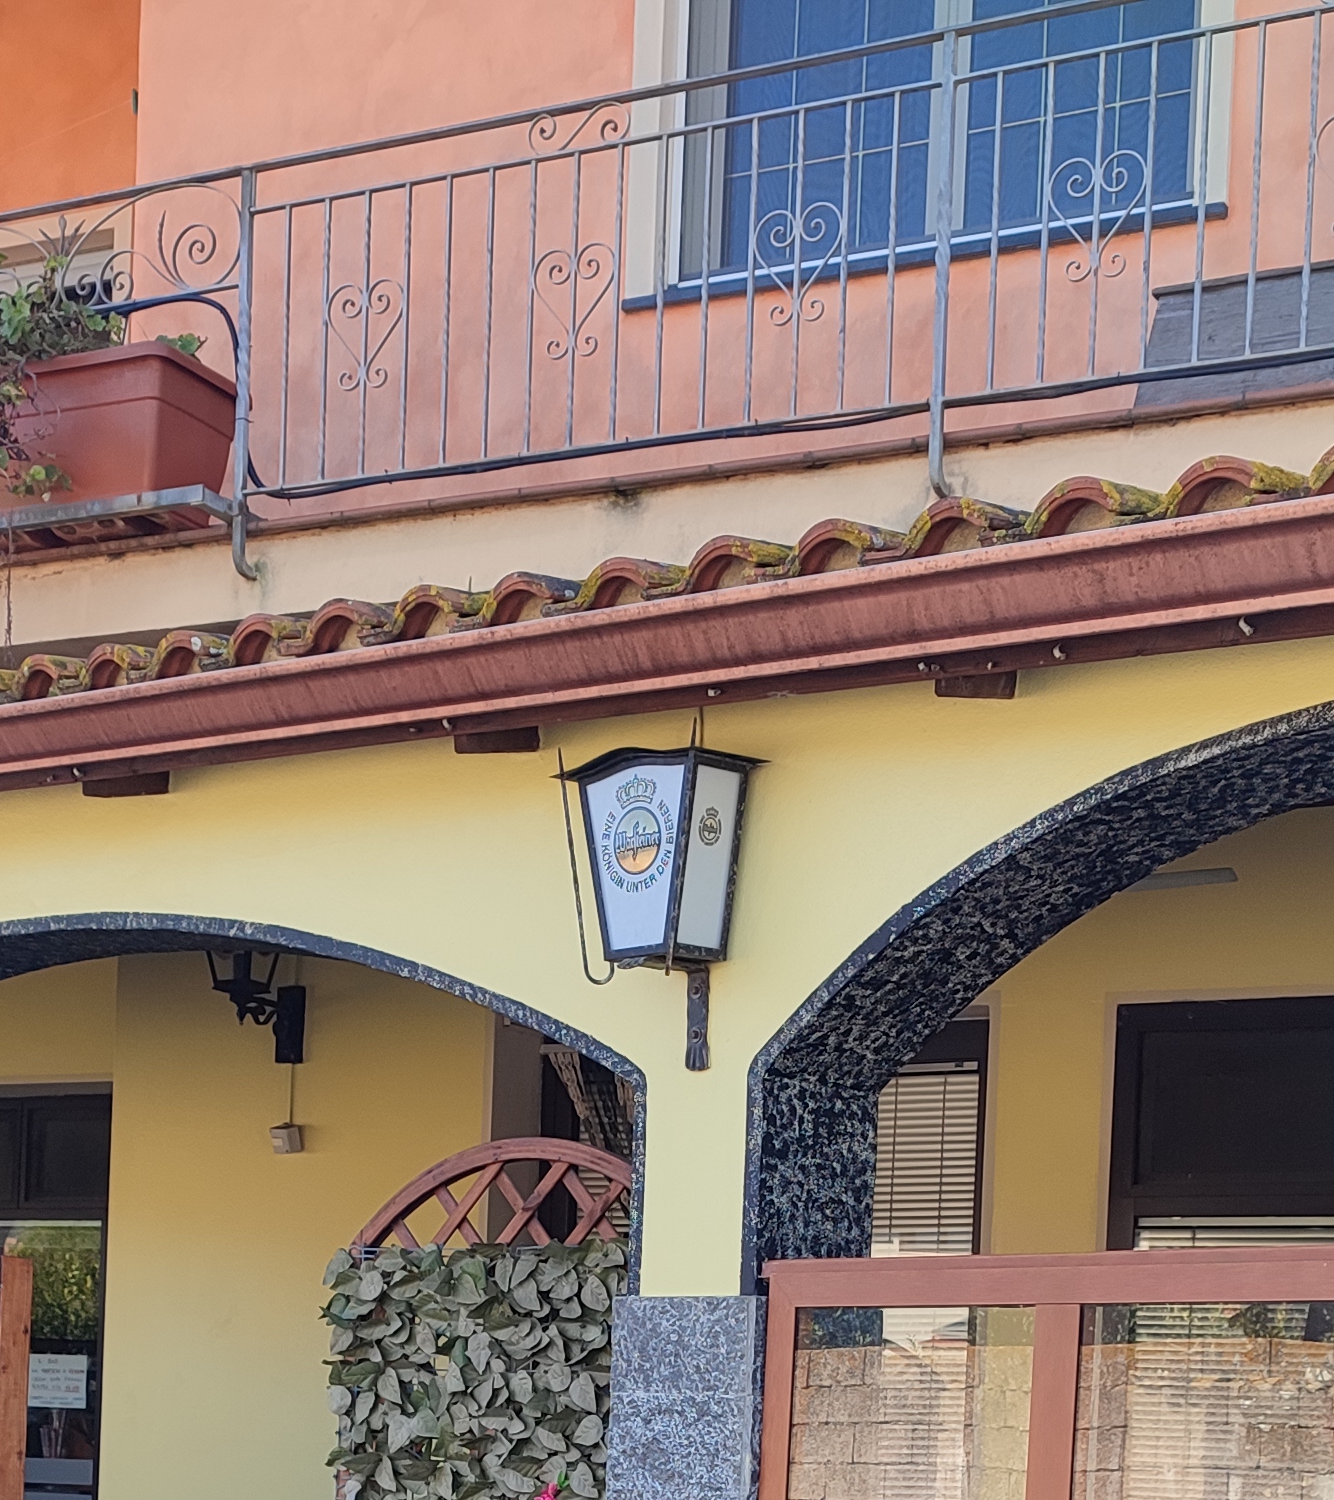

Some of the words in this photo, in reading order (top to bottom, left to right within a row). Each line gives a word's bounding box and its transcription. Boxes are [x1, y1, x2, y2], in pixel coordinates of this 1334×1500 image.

[601, 811, 616, 841] EINE
[657, 800, 674, 844] BIEREN
[601, 844, 625, 889] KÖNIGIN
[656, 849, 672, 876] DEN
[625, 873, 657, 893] UNTER
